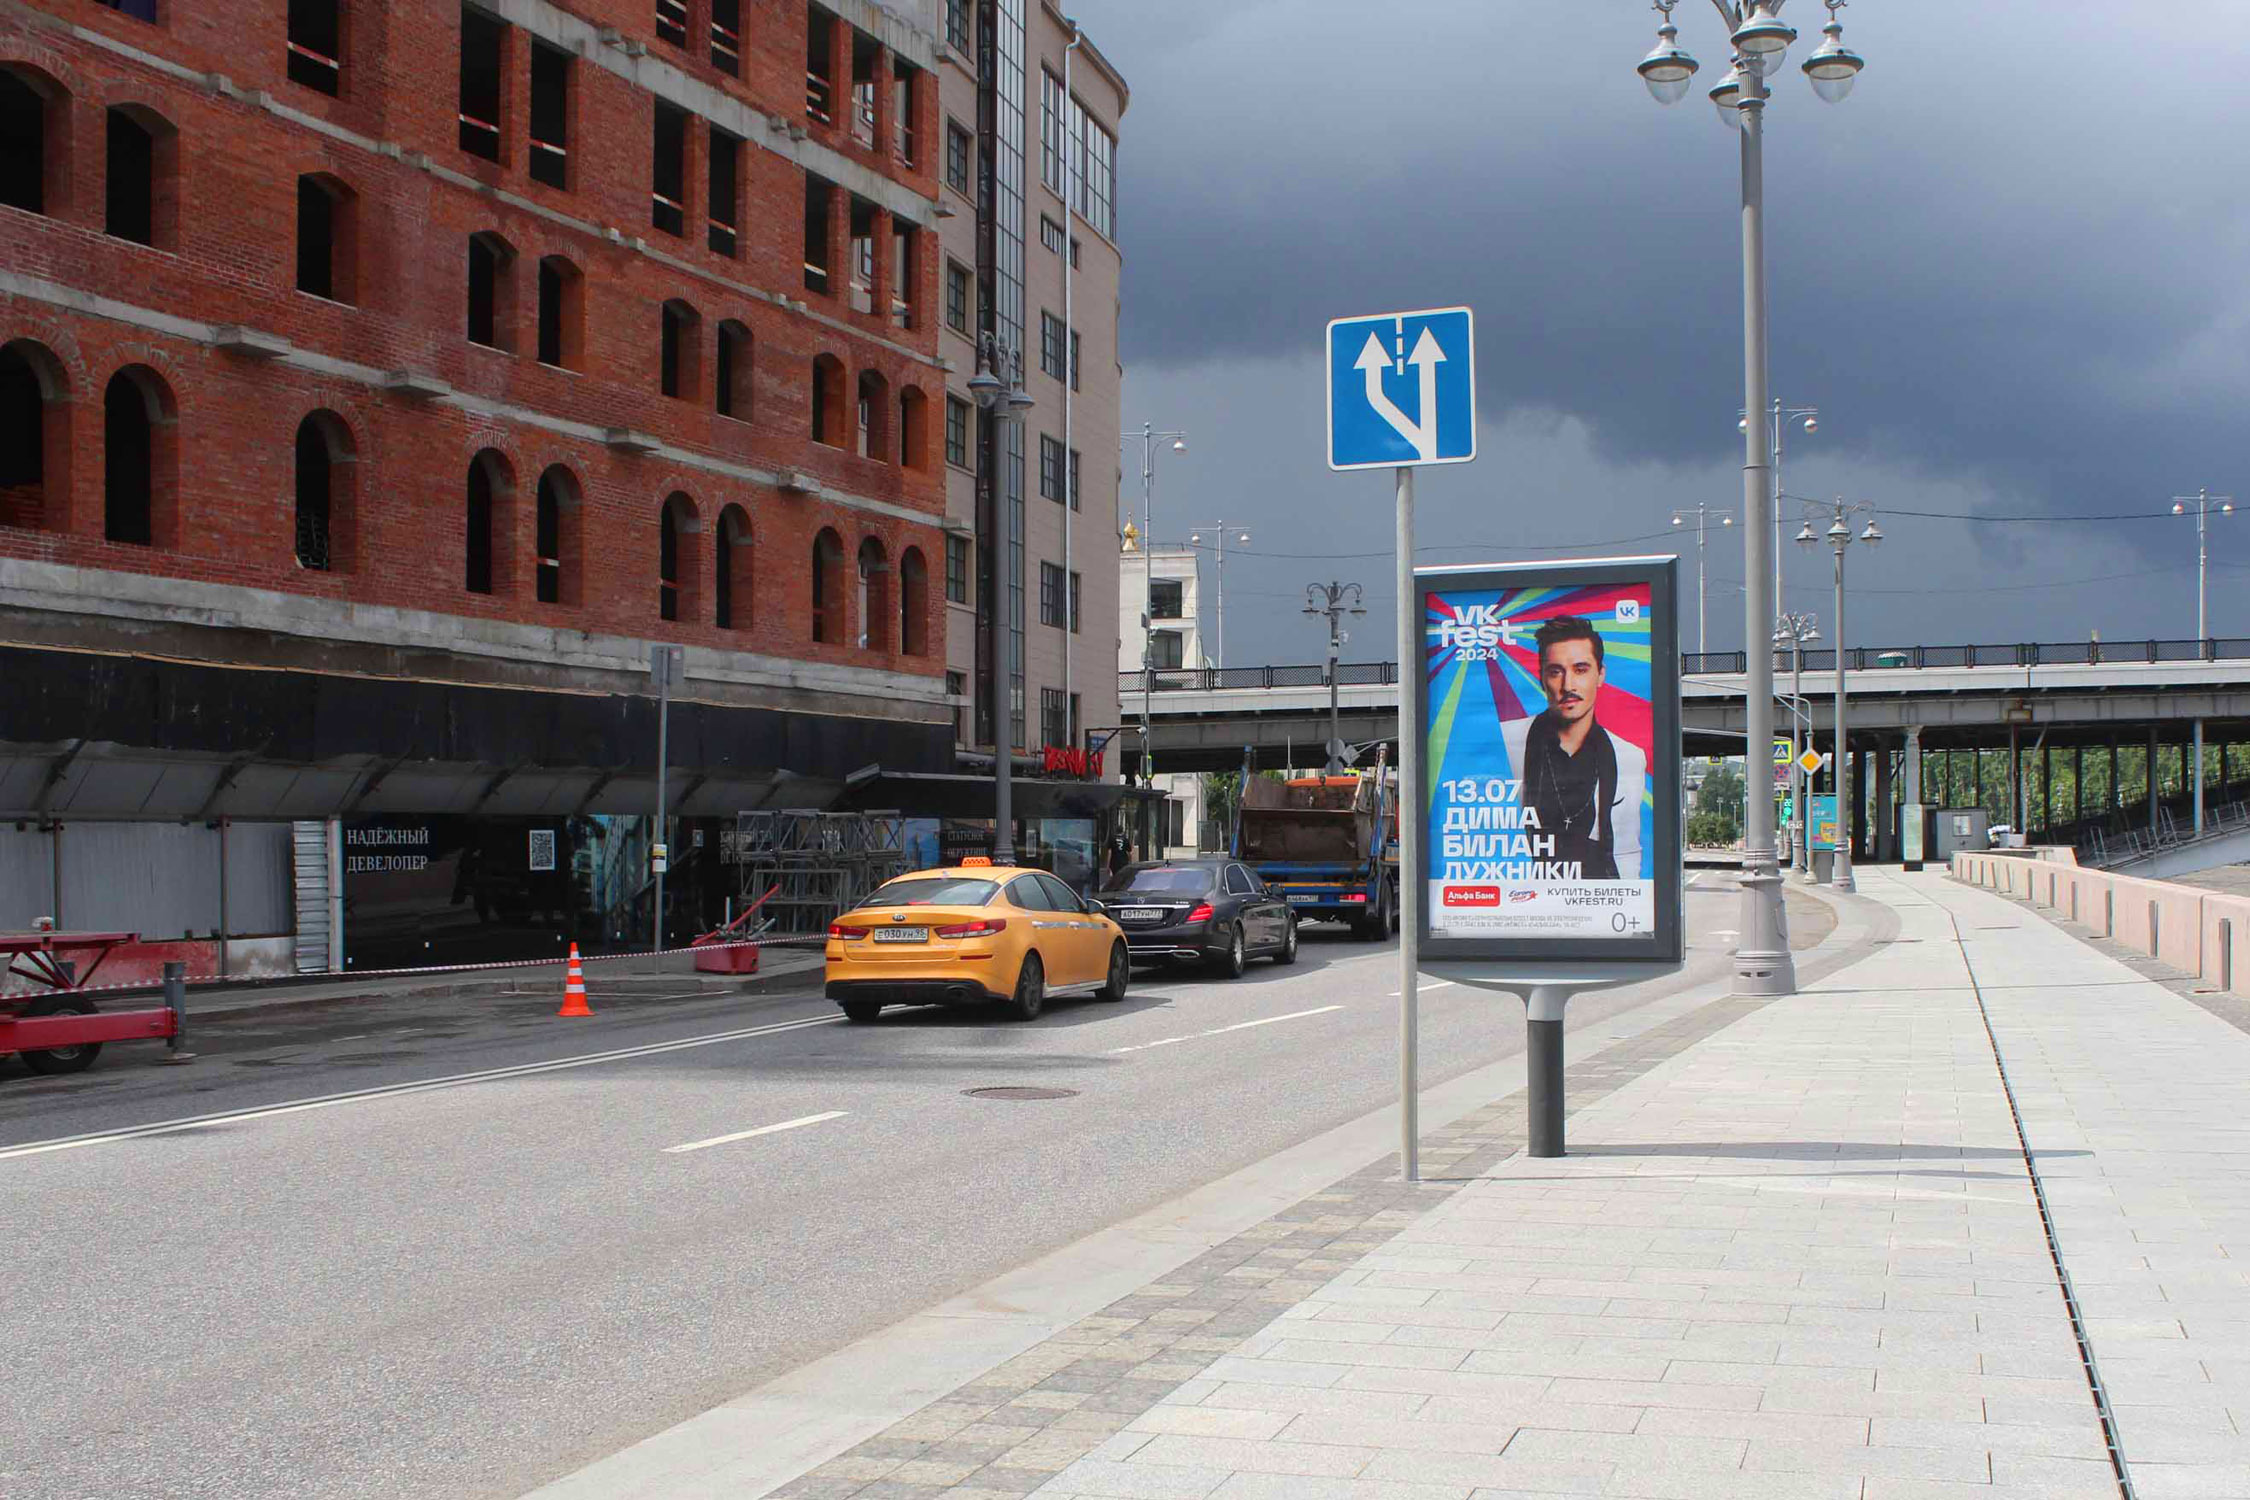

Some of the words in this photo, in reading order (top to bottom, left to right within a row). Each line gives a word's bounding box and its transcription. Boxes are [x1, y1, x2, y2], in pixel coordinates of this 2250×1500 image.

[1454, 604, 1499, 625] VK
[1620, 606, 1635, 617] VK
[1440, 619, 1523, 648] fest
[1455, 647, 1498, 661] 2024
[1443, 779, 1523, 804] 13.07
[1442, 806, 1541, 833] ДИМА
[346, 826, 429, 847] НАДЁЖНЫЙ
[1443, 834, 1555, 858] БИЛАН
[346, 855, 428, 873] ДЕВЕЛОПЕР
[1442, 860, 1582, 881] ЛУЖНИКИ
[1475, 891, 1495, 900] Банк
[1547, 888, 1591, 897] КУПИТЬ
[1594, 888, 1641, 896] БИЛЕТЫ
[1564, 897, 1623, 906] VKFEST.RU
[1611, 912, 1641, 933] 0+
